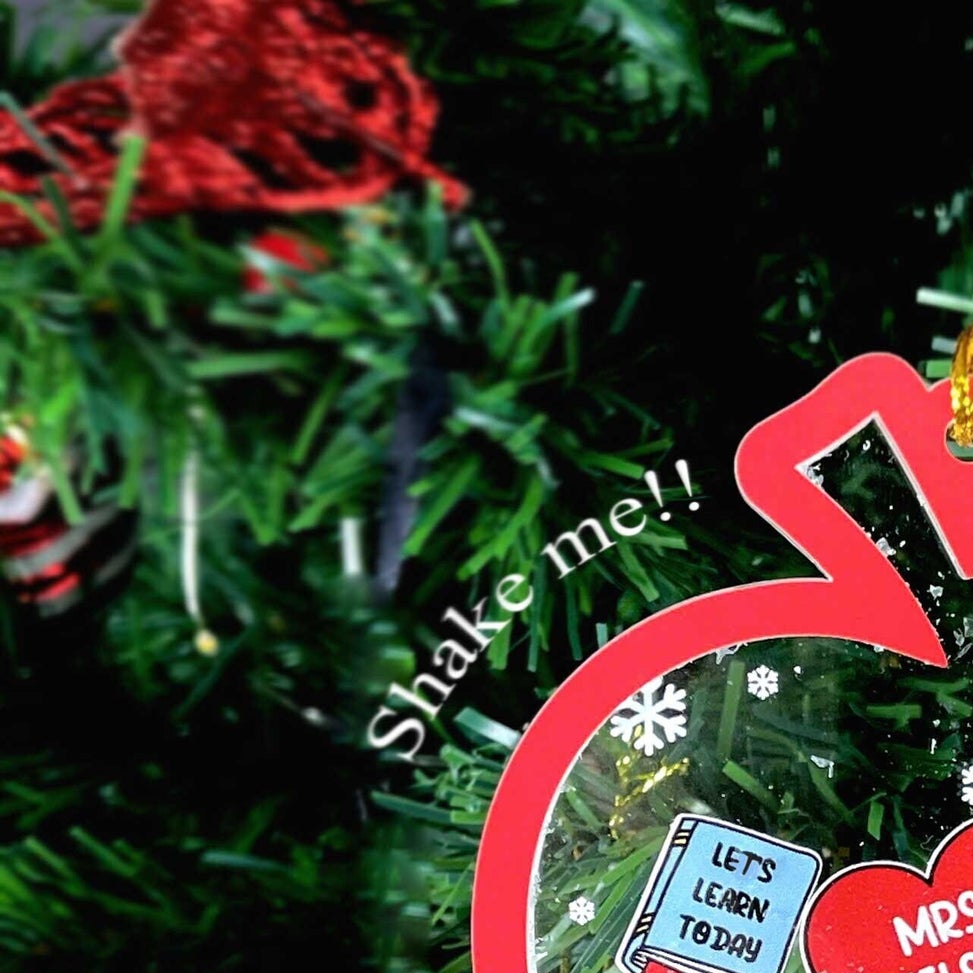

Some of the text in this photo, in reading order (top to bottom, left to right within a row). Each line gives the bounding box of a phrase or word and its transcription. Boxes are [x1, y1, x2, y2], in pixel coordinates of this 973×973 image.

[711, 841, 776, 883] LET'S
[693, 878, 770, 923] LEARN
[679, 914, 763, 963] TODAY
